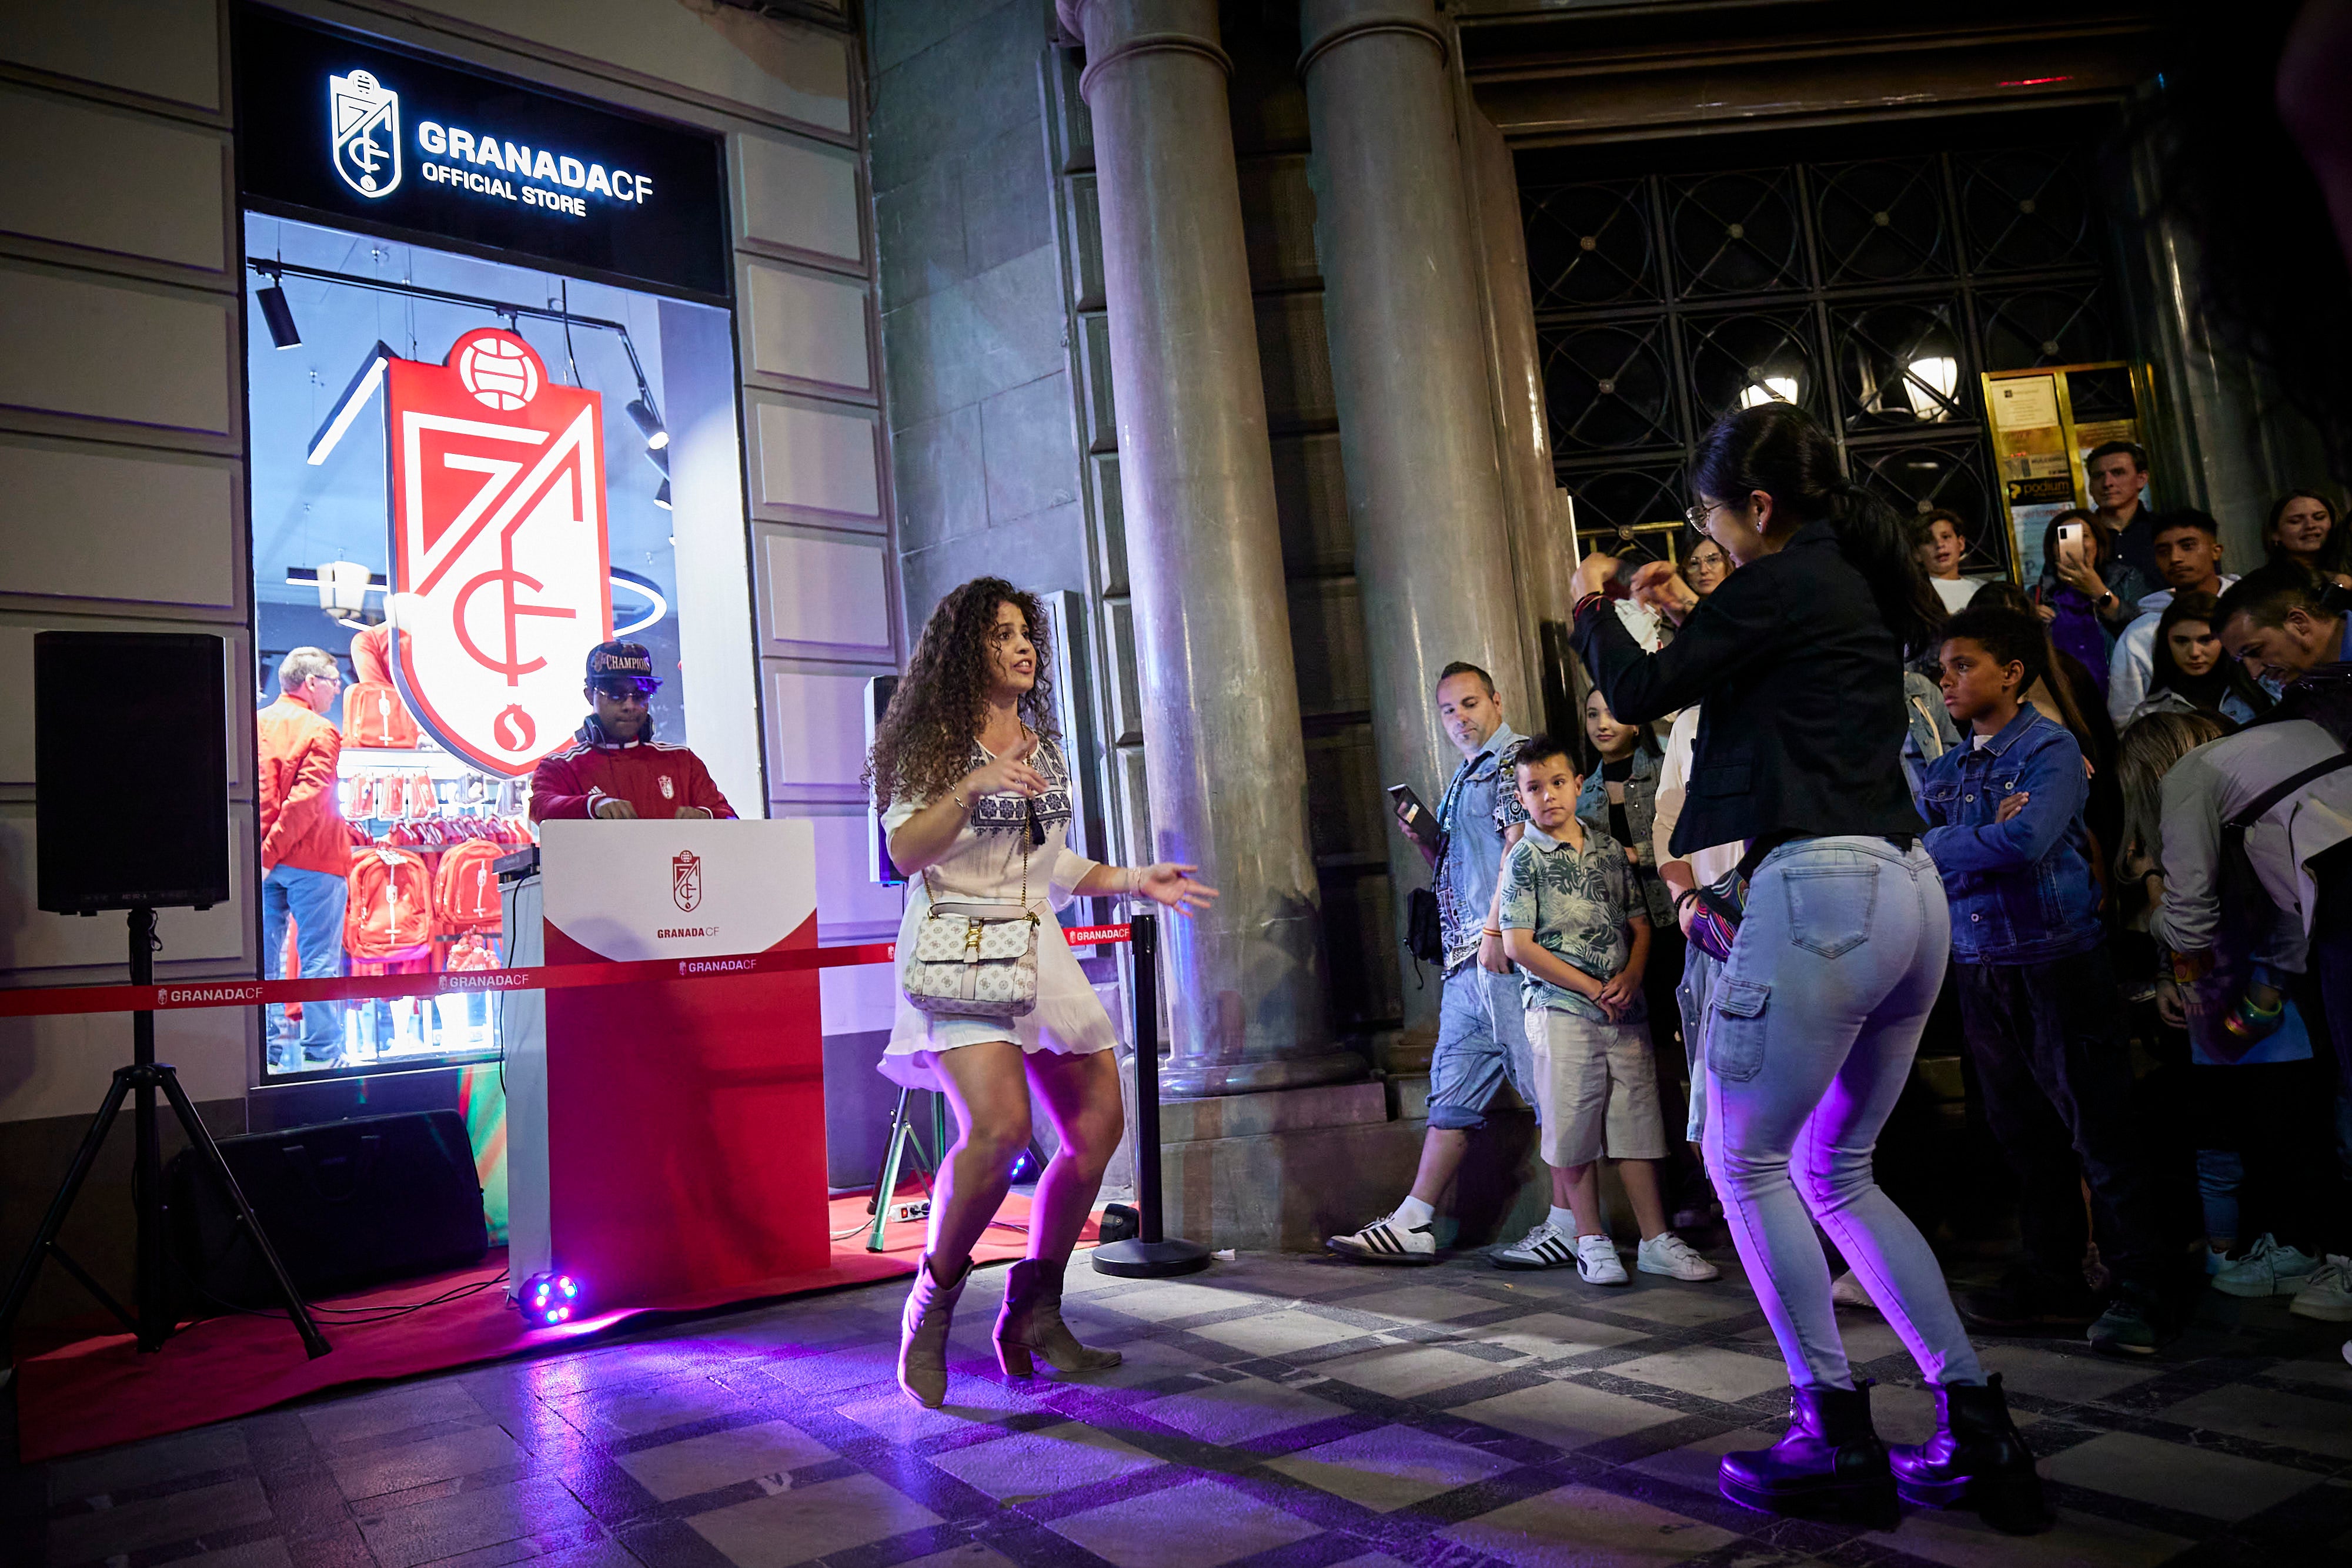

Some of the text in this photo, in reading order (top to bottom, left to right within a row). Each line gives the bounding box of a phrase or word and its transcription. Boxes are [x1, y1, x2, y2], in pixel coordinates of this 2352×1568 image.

[418, 121, 653, 205] GRANADACF
[422, 162, 587, 218] OFFICIAL STORE
[2023, 480, 2070, 496] podium
[657, 927, 719, 938] GRANADACF
[1077, 928, 1129, 941] GRANADACF
[689, 959, 757, 972] GRANADACF
[449, 974, 529, 988] GRANADACF
[171, 988, 263, 1001] GRANADACF
